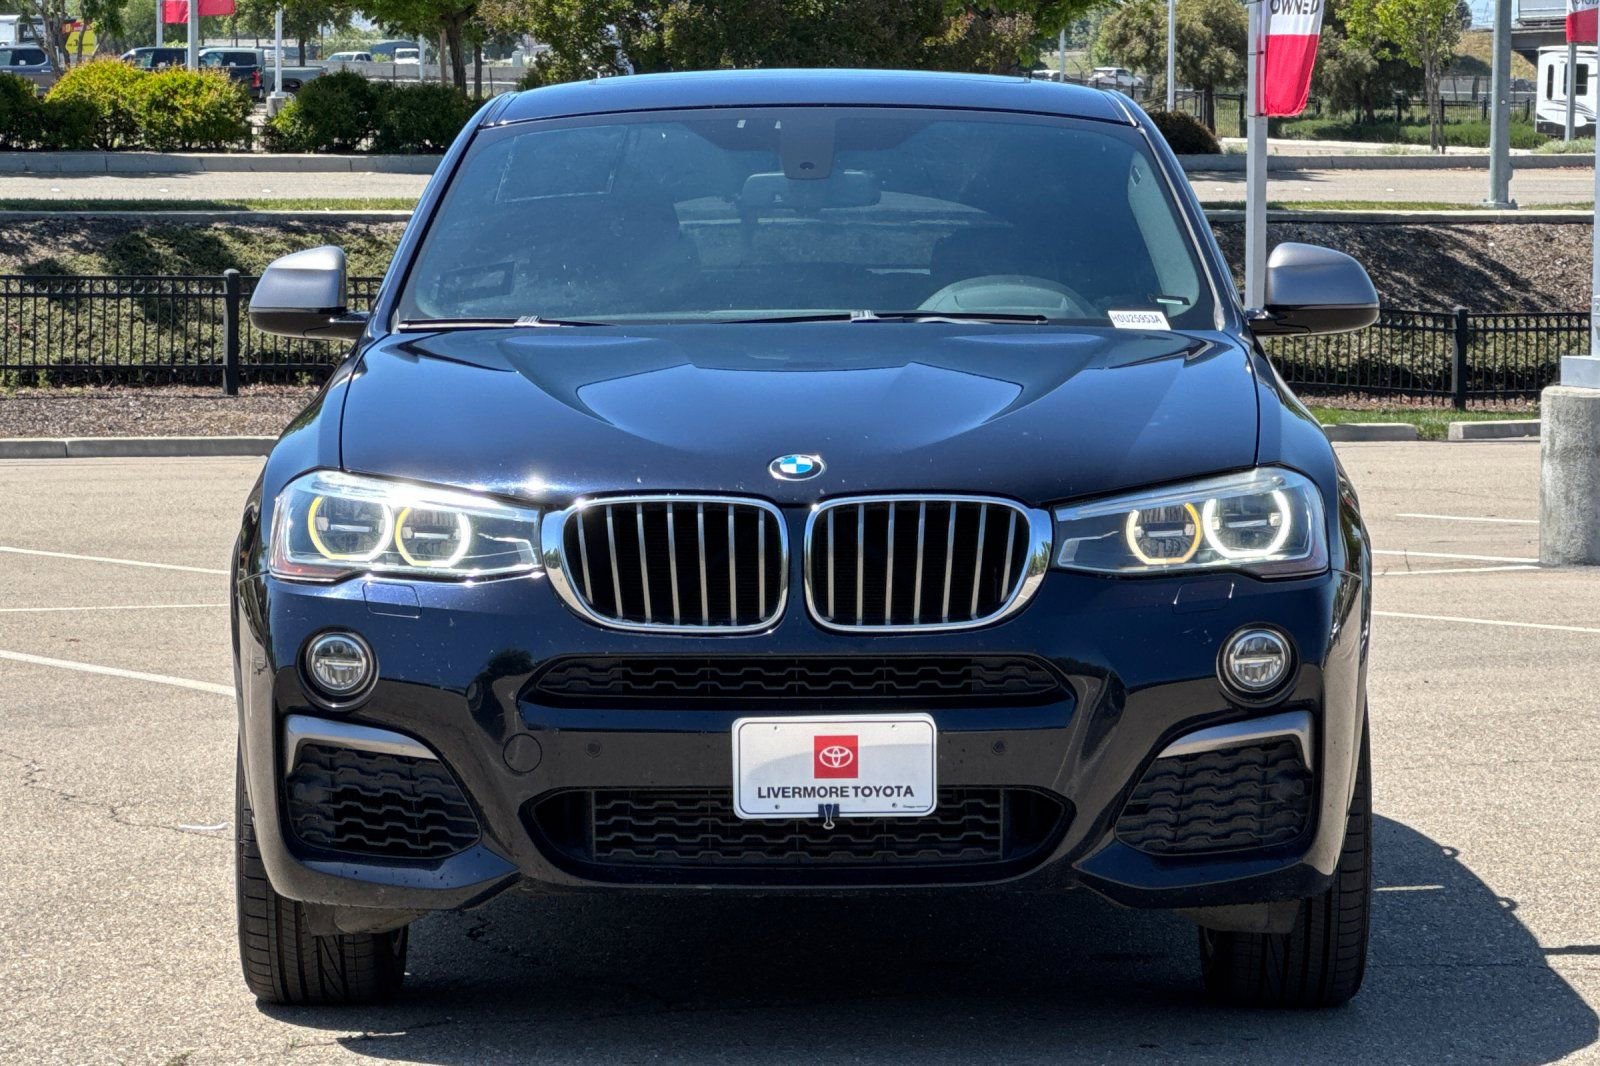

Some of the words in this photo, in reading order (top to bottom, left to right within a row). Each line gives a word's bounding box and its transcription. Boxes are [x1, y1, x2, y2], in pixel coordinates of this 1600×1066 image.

[1270, 0, 1320, 15] OWNED
[757, 786, 850, 799] LIVERMORE
[852, 785, 914, 798] TOYOTA
